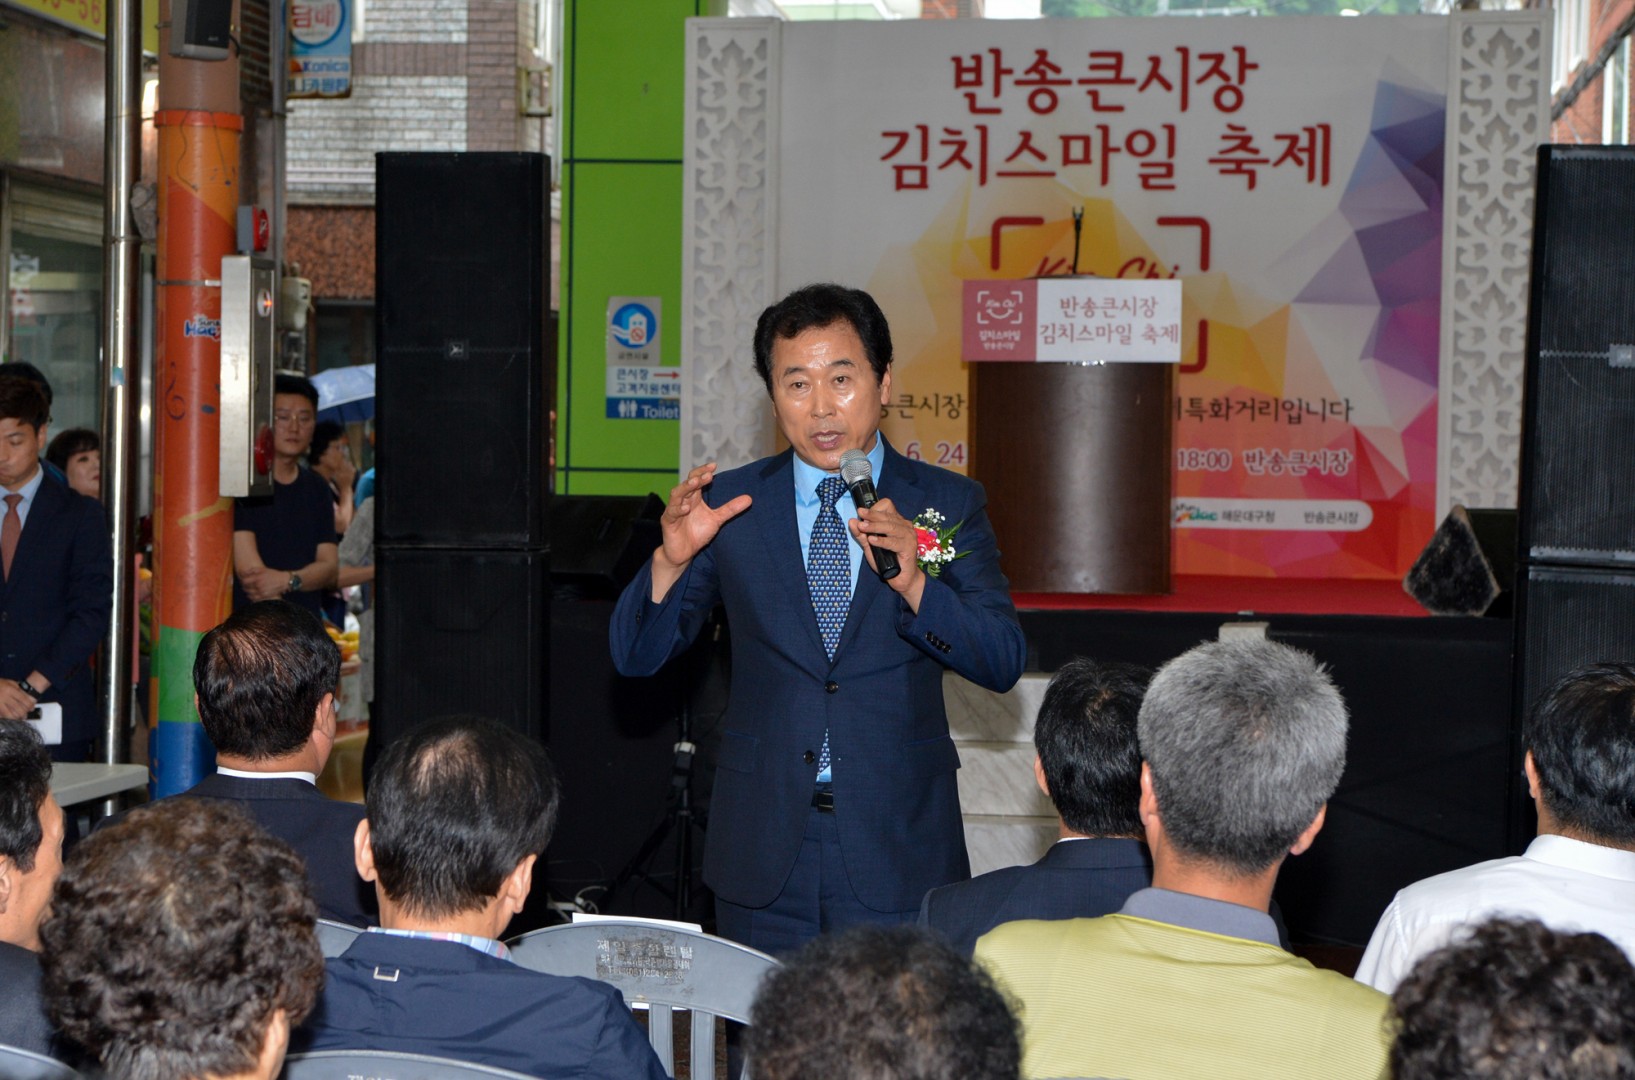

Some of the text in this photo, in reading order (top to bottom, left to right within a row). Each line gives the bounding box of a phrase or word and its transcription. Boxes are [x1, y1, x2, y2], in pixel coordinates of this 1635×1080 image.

[303, 60, 349, 72] Konica
[950, 46, 1259, 115] 반송큰시장
[880, 123, 1332, 191] 김치스마일 축제
[1060, 297, 1159, 318] 반송큰시장
[979, 330, 1021, 342] 김치스마일
[1040, 323, 1180, 345] 김치스마일 축제
[616, 368, 648, 381] 큰시장
[641, 404, 679, 419] Toilet
[1178, 450, 1230, 470] 18:00
[1244, 450, 1350, 474] 반송큰시장
[1221, 510, 1276, 523] 해운대구청
[1304, 511, 1359, 524] 반송큰시장
